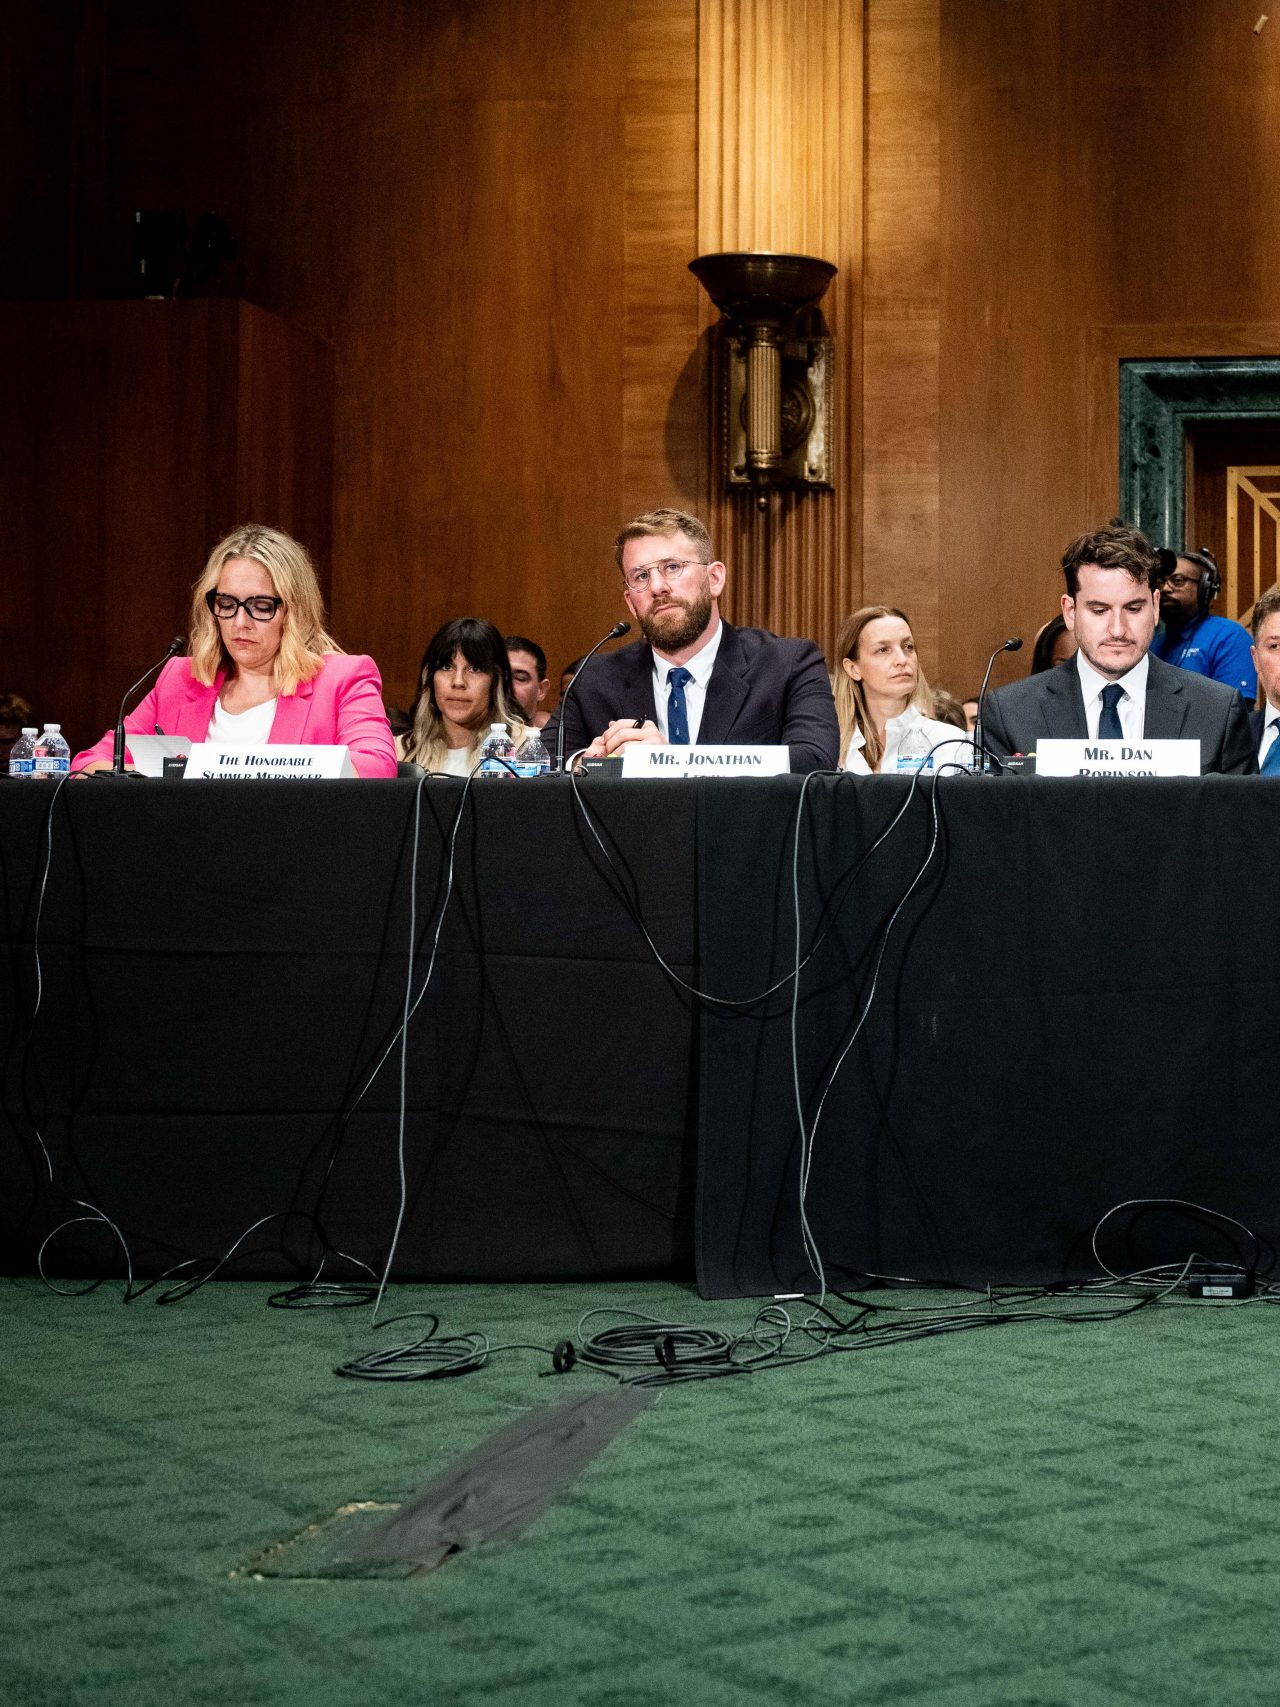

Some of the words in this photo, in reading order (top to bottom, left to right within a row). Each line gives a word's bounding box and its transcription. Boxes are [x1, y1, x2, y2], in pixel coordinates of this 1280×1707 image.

[649, 752, 680, 765] MR.
[685, 752, 762, 765] JONATHAN
[1084, 747, 1114, 760] MR.
[1121, 747, 1153, 760] DAN
[219, 754, 243, 766] THE
[244, 755, 315, 767] HONORABLE
